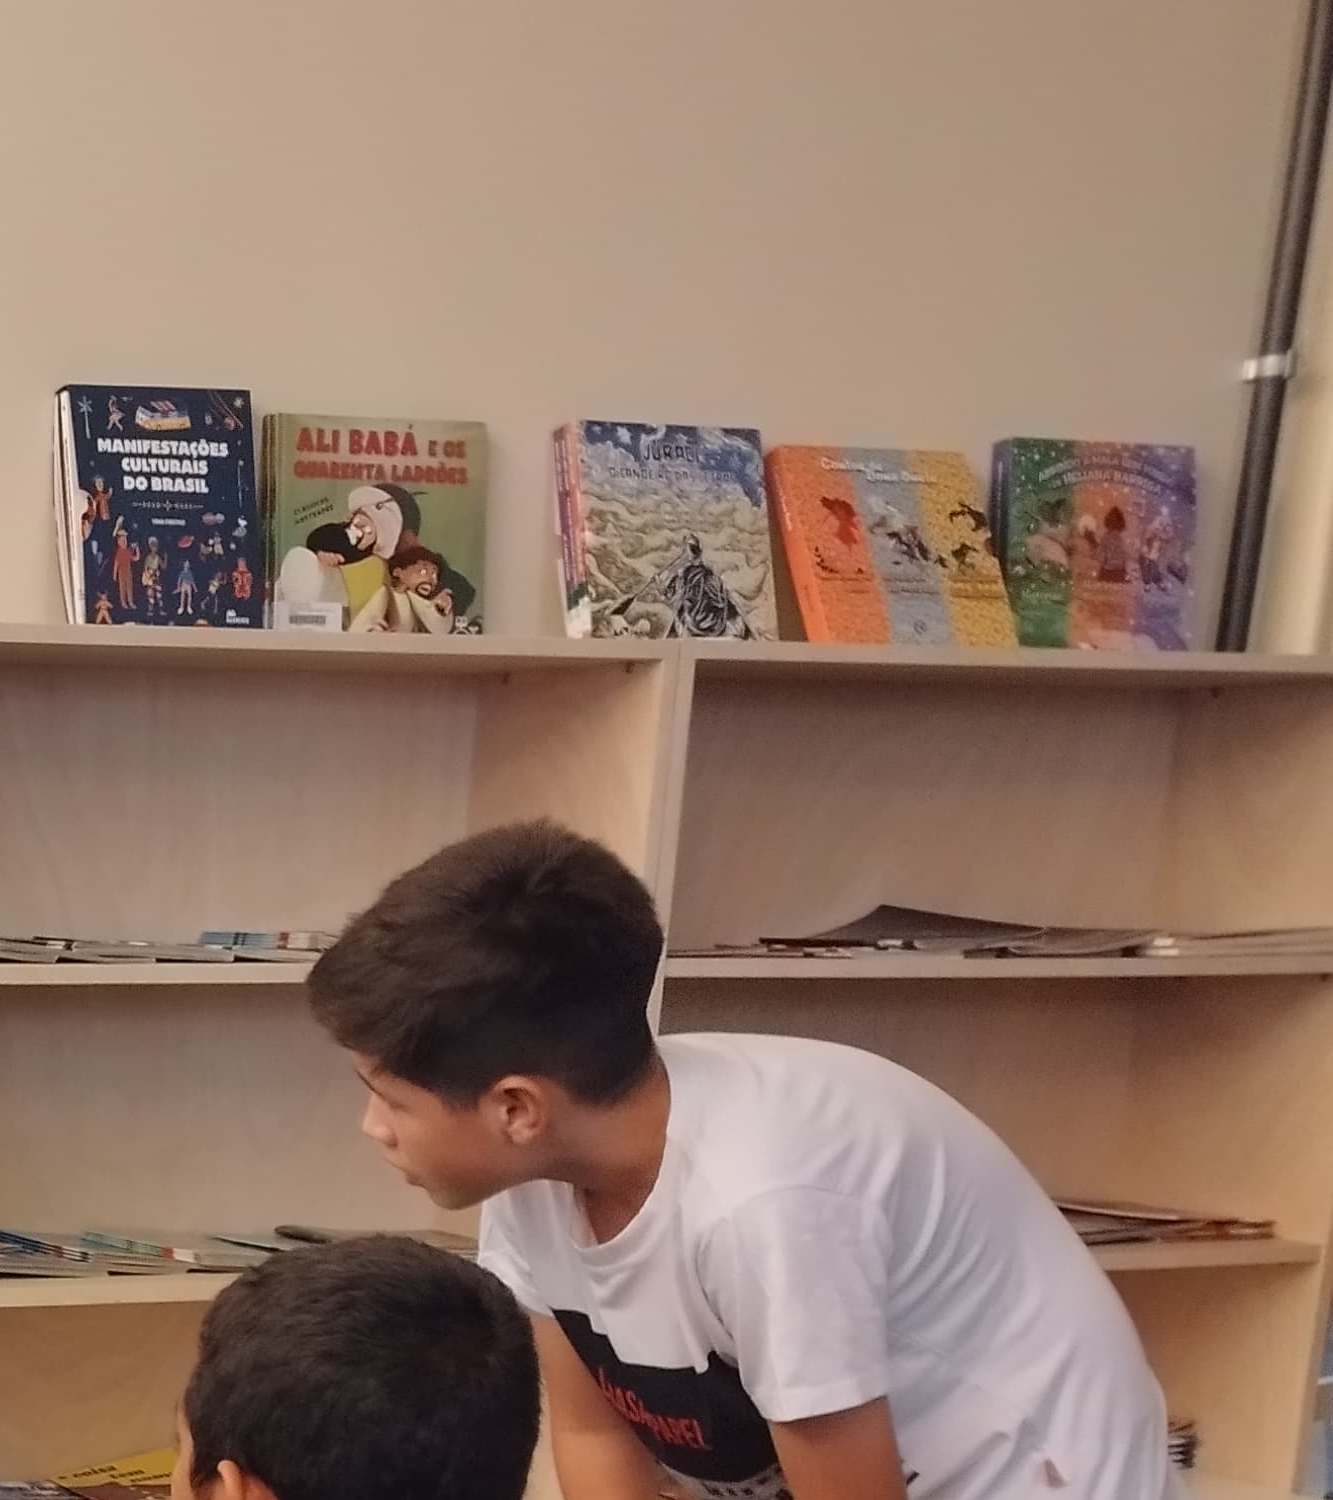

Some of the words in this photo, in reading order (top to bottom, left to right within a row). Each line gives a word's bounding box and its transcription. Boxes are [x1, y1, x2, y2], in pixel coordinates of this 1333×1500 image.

[97, 437, 229, 458] MANIFESTAÇÕES
[296, 427, 340, 453] ALI
[348, 424, 418, 456] BABÁ
[428, 440, 437, 457] E
[443, 440, 466, 458] OS
[121, 457, 209, 475] CULTURAIS
[294, 460, 386, 481] QUARENTA
[391, 461, 469, 485] LADRÕES
[123, 475, 148, 491] DO
[151, 476, 209, 494] BRASIL
